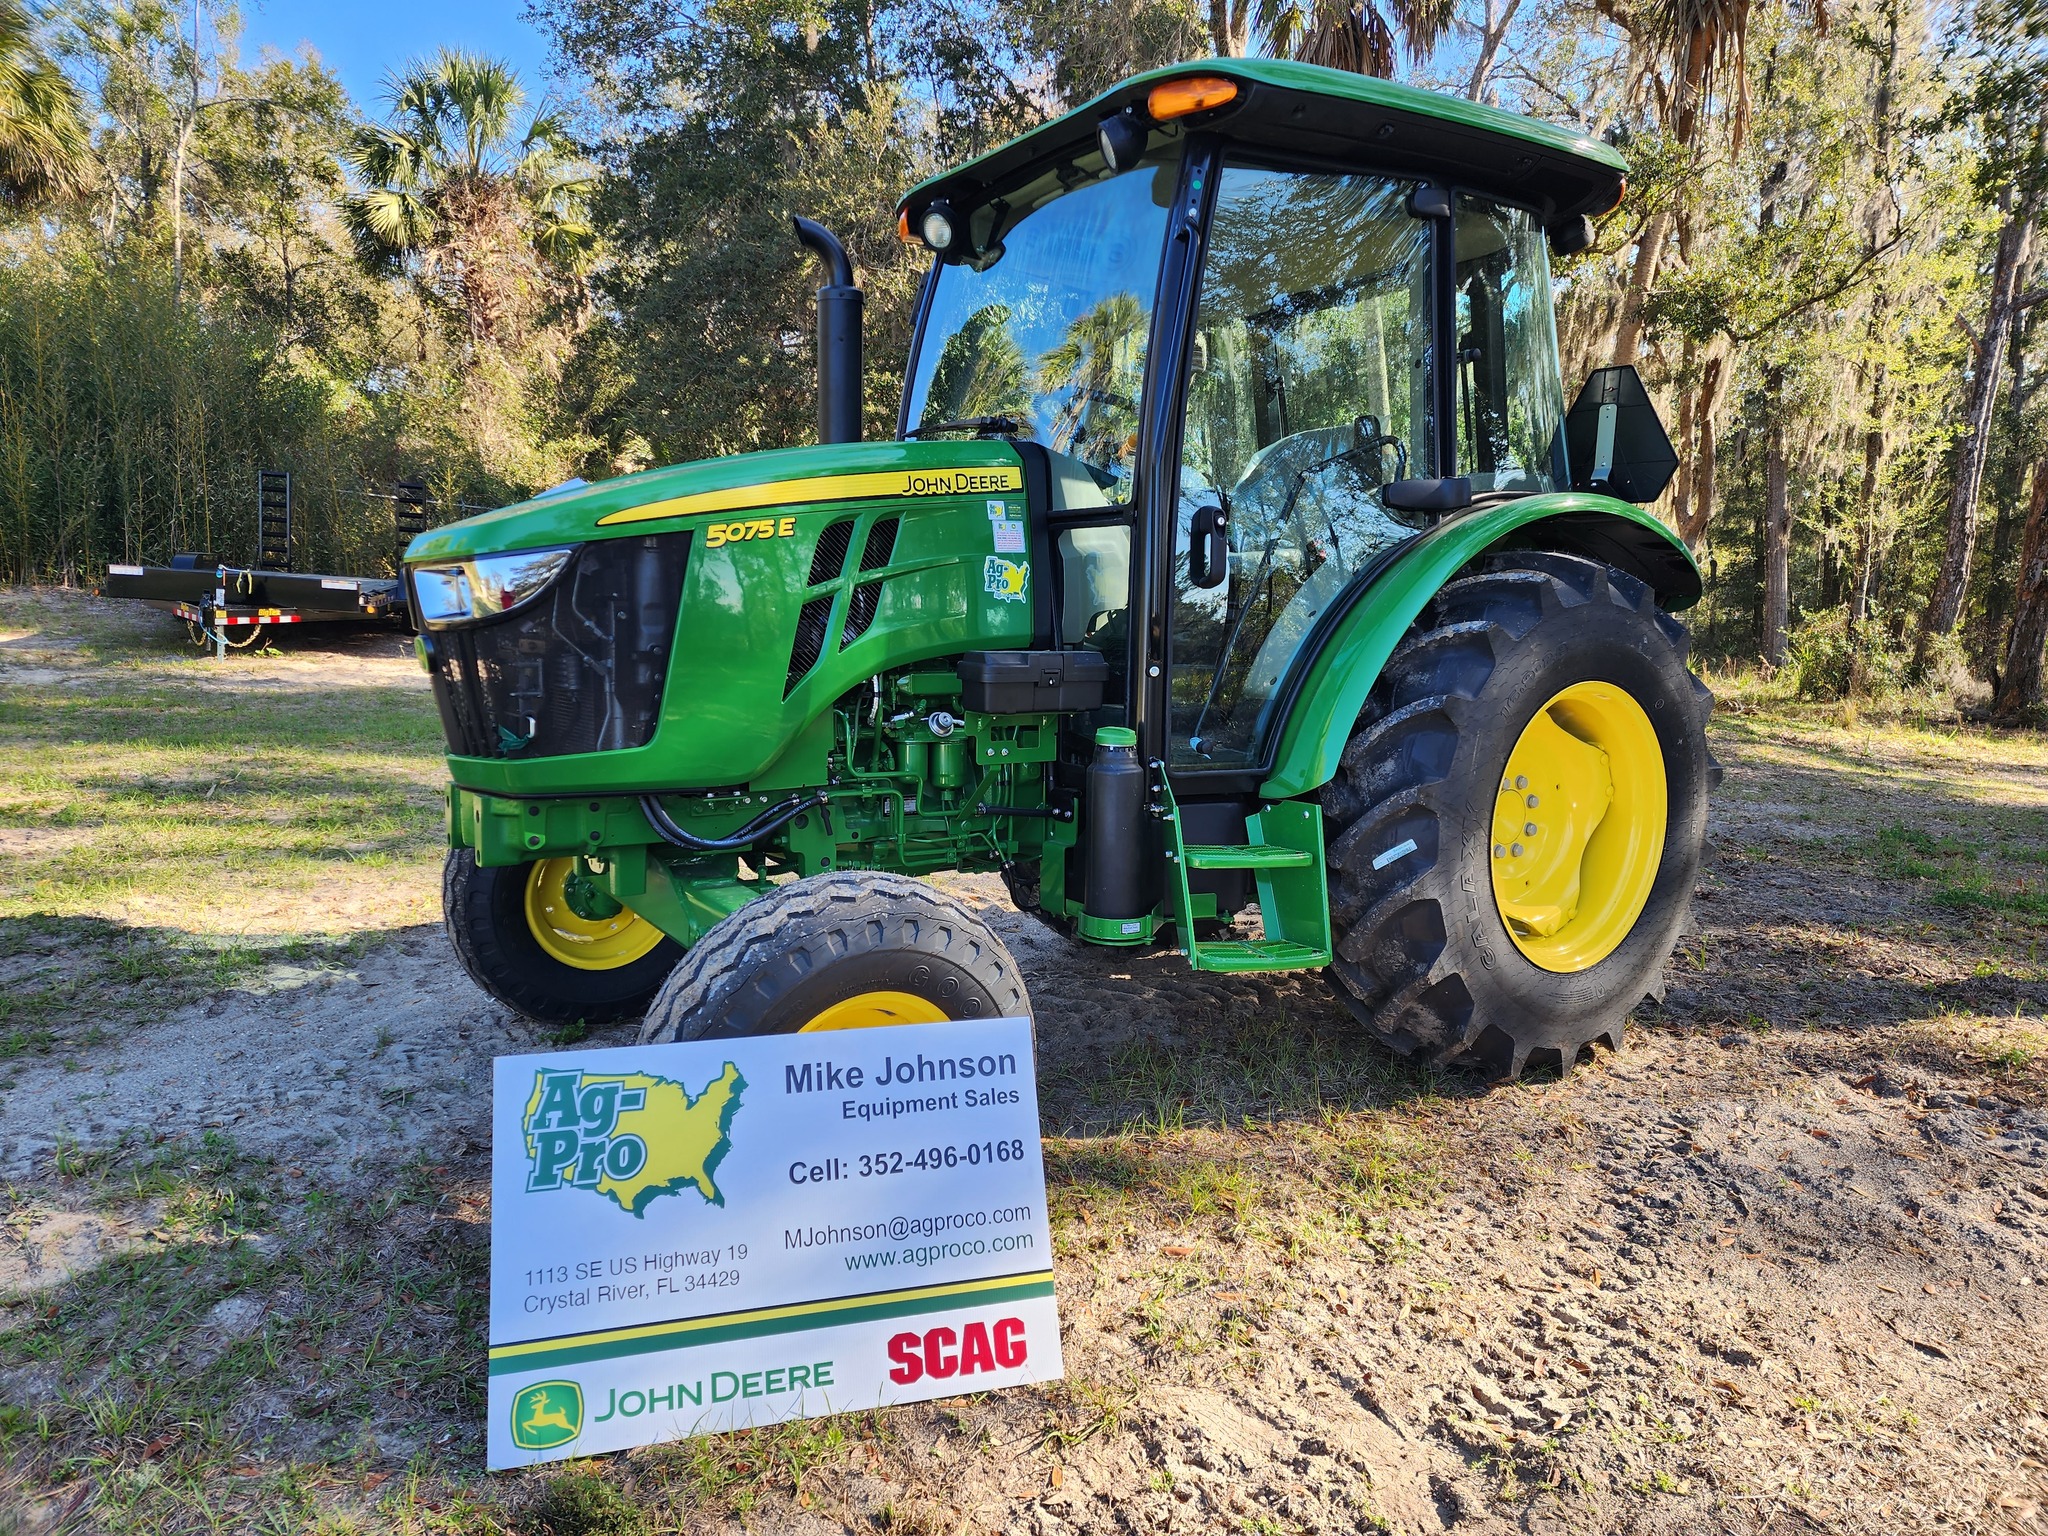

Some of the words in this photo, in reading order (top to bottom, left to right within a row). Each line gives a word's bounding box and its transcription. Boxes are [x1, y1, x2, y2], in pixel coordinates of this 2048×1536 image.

[902, 475, 952, 493] JOHN
[955, 473, 1010, 491] DEERE
[705, 519, 776, 549] 5075
[778, 517, 797, 538] E
[987, 559, 1009, 578] Ag-
[988, 575, 1009, 590] Pro
[1460, 799, 1497, 970] GALAXY
[785, 1061, 864, 1095] Mike
[875, 1053, 1016, 1086] Johnson
[529, 1070, 646, 1139] Ag-
[842, 1091, 959, 1122] Equipment
[965, 1088, 1020, 1108] Sales
[527, 1131, 647, 1191] Pro
[789, 1158, 848, 1185] Cell:
[858, 1139, 1025, 1178] 352-496-0168
[784, 1206, 1031, 1250] MJohnson@agproco.com
[525, 1266, 569, 1287] 1113
[575, 1261, 603, 1281] SE
[609, 1257, 638, 1277] US
[644, 1248, 721, 1273] Highway
[727, 1243, 748, 1261] 19
[845, 1233, 1034, 1271] www.agproco.com
[524, 1288, 590, 1315] Crystal
[598, 1283, 650, 1304] River,
[657, 1277, 680, 1295] FL
[684, 1269, 741, 1293] 34429
[887, 1317, 1028, 1386] SCAG
[594, 1381, 703, 1423] JOHN
[711, 1361, 835, 1404] DEERE
